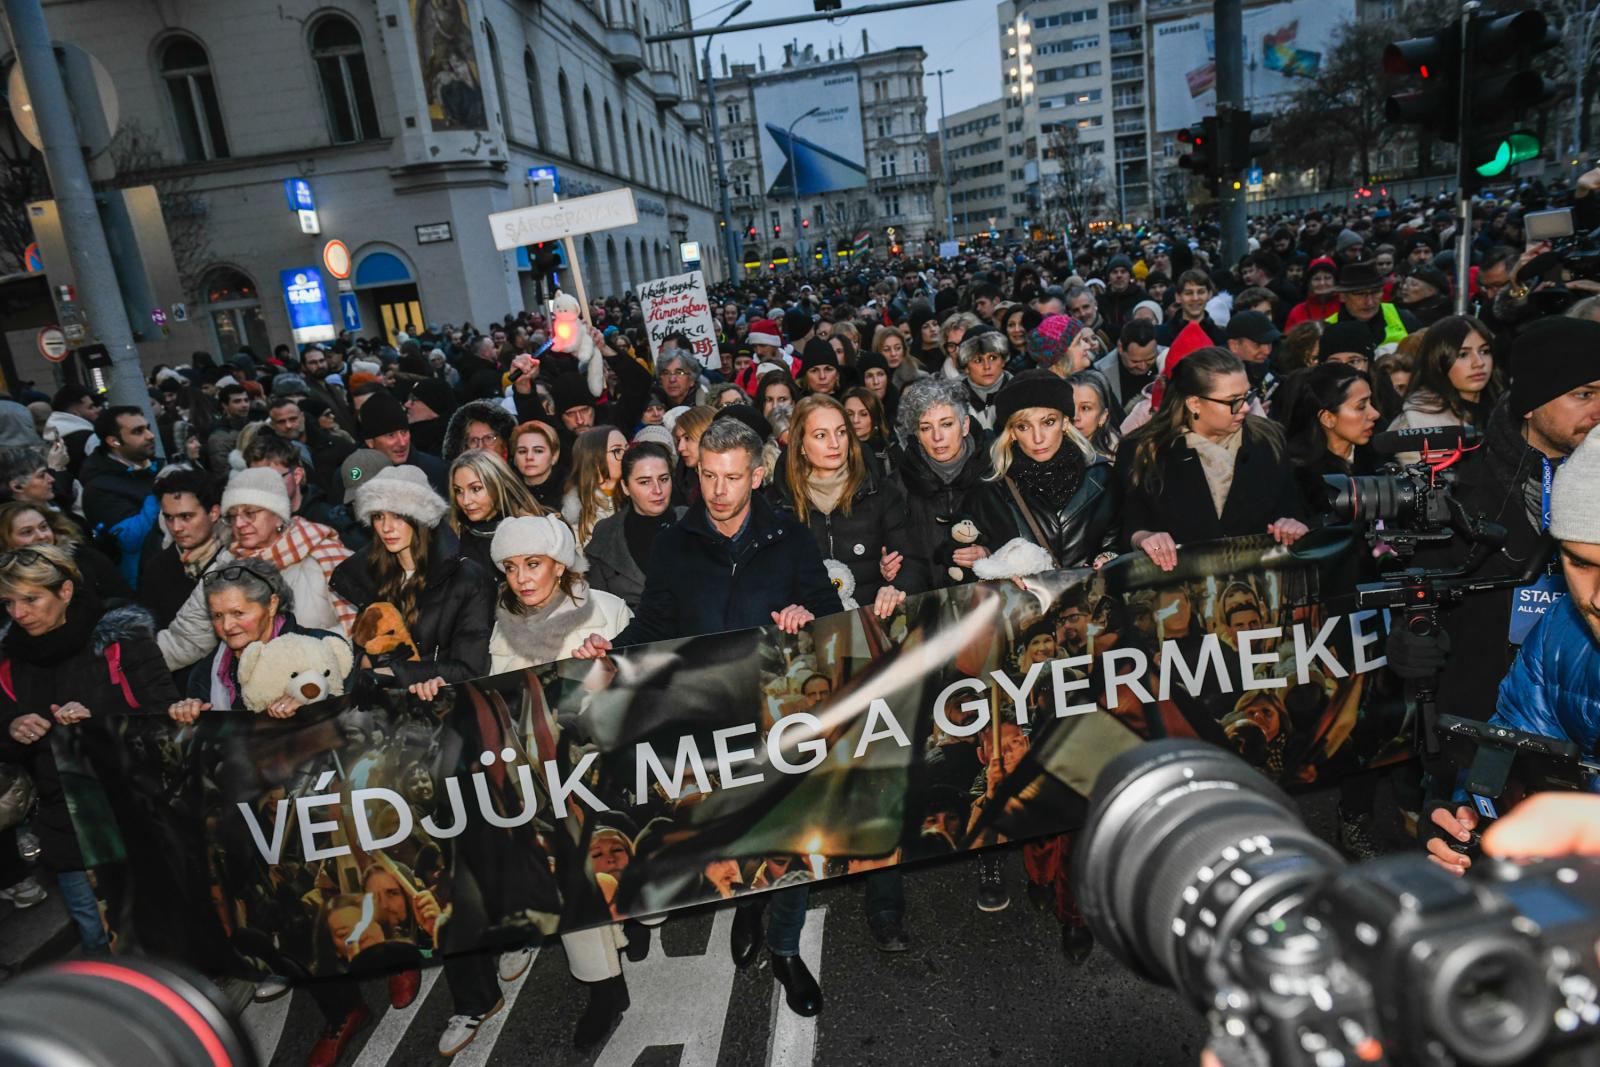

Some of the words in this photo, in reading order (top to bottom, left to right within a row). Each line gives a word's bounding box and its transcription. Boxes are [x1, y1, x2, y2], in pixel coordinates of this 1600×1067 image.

[1158, 22, 1201, 36] SAMSUNG
[1519, 589, 1566, 604] STAF
[1517, 605, 1534, 613] ALL
[237, 748, 610, 866] VÉDJÜK
[634, 711, 828, 806] MEG
[853, 697, 912, 758] A
[933, 608, 1392, 738] GYERMEKE
